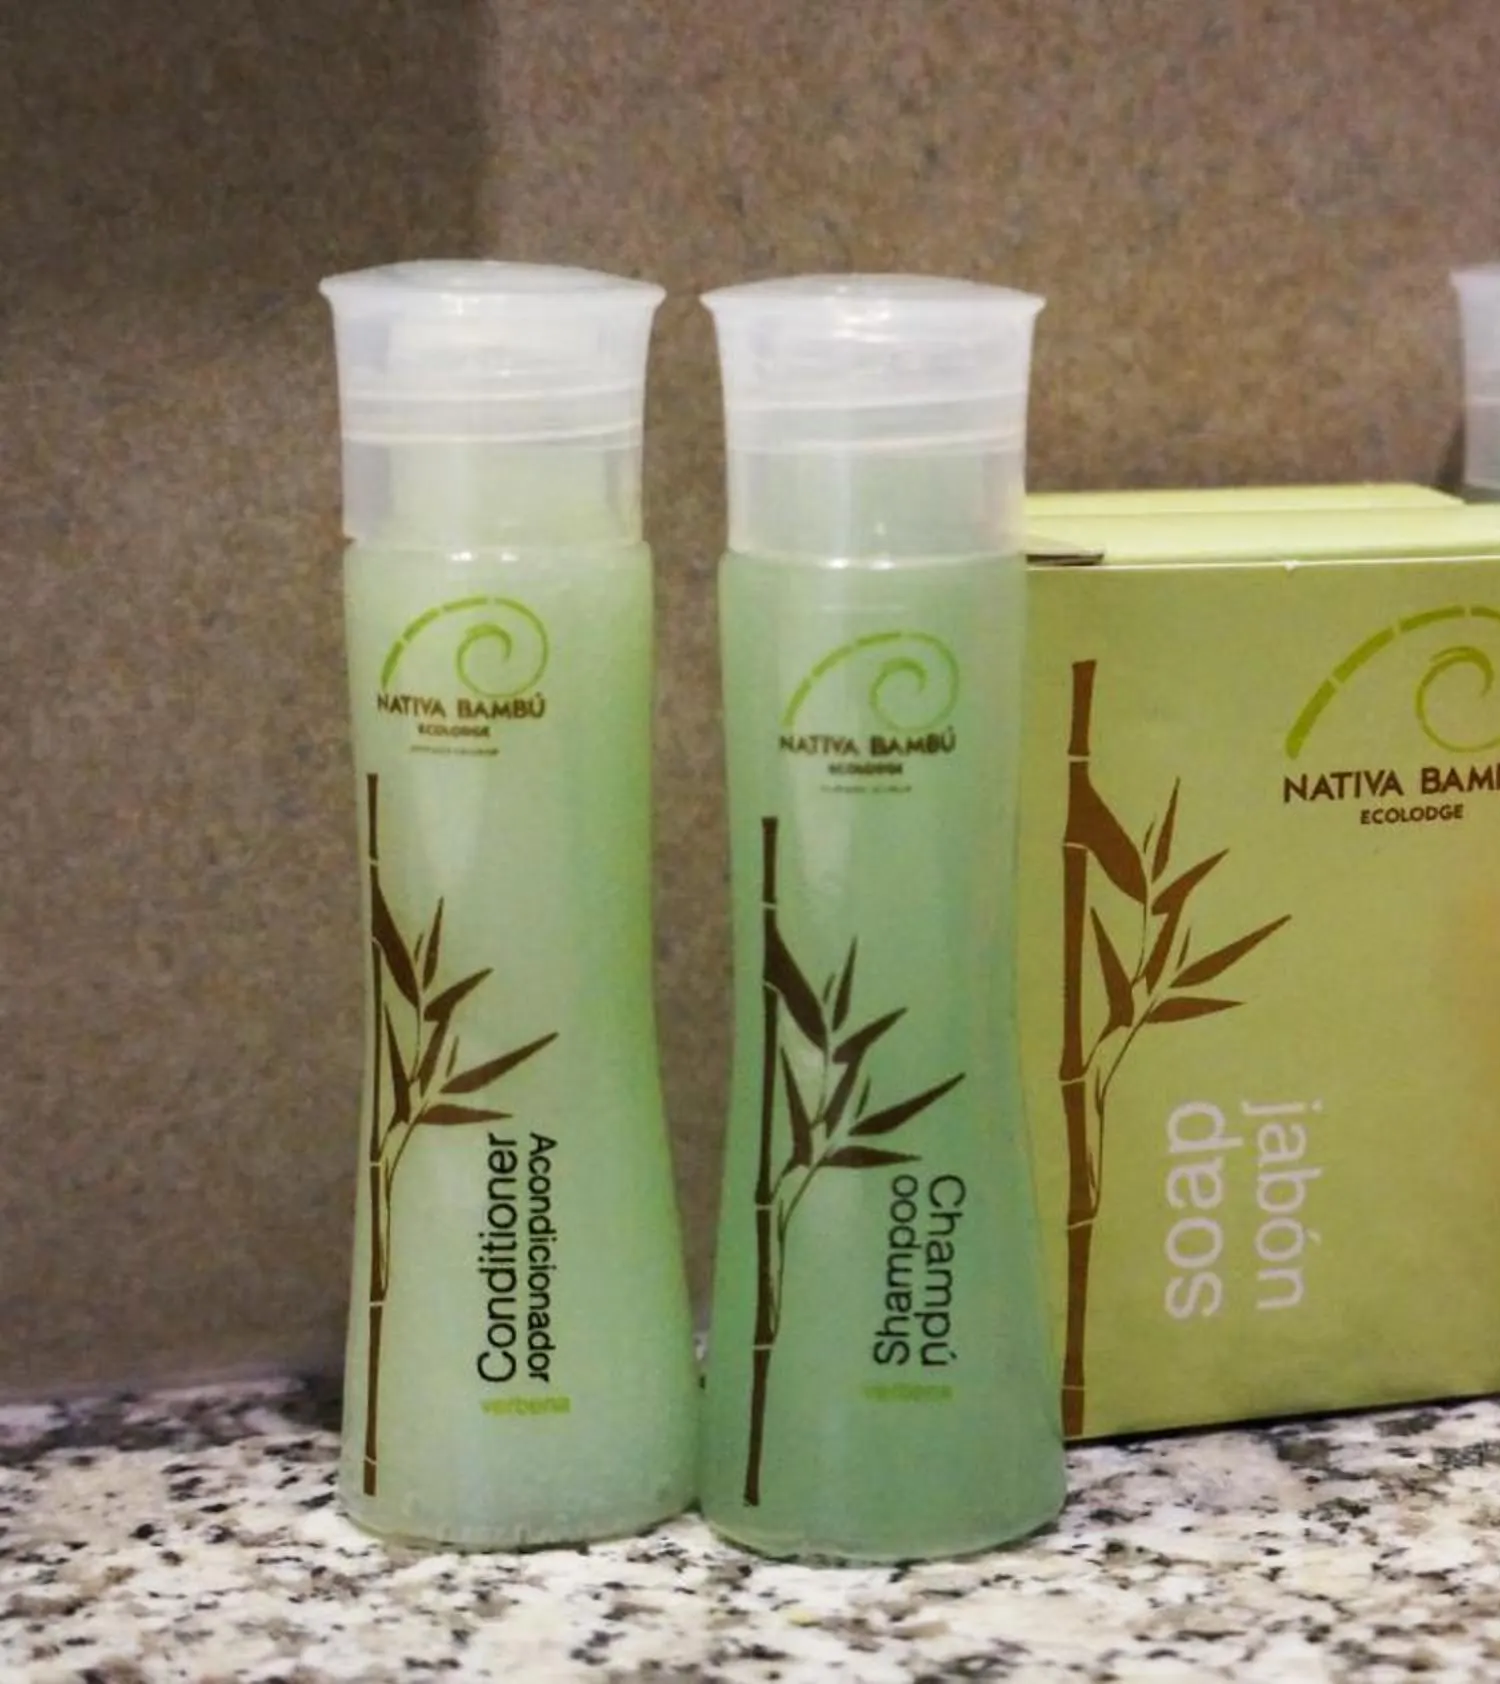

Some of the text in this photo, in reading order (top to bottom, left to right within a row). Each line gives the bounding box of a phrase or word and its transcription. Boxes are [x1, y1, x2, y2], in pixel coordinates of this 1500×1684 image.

[377, 691, 545, 719] NATIVA BAMBÚ
[779, 725, 956, 757] NATIVA BAMBÚ
[1284, 768, 1403, 803] NATIVA
[1360, 803, 1464, 825] ECOLODGE
[477, 1131, 518, 1384] Conditioner
[527, 1132, 557, 1383] Acondicionador
[873, 1173, 918, 1366] Shampoo
[920, 1173, 966, 1367] Champú
[1165, 1101, 1244, 1319] soap
[1241, 1099, 1324, 1311] jabón
